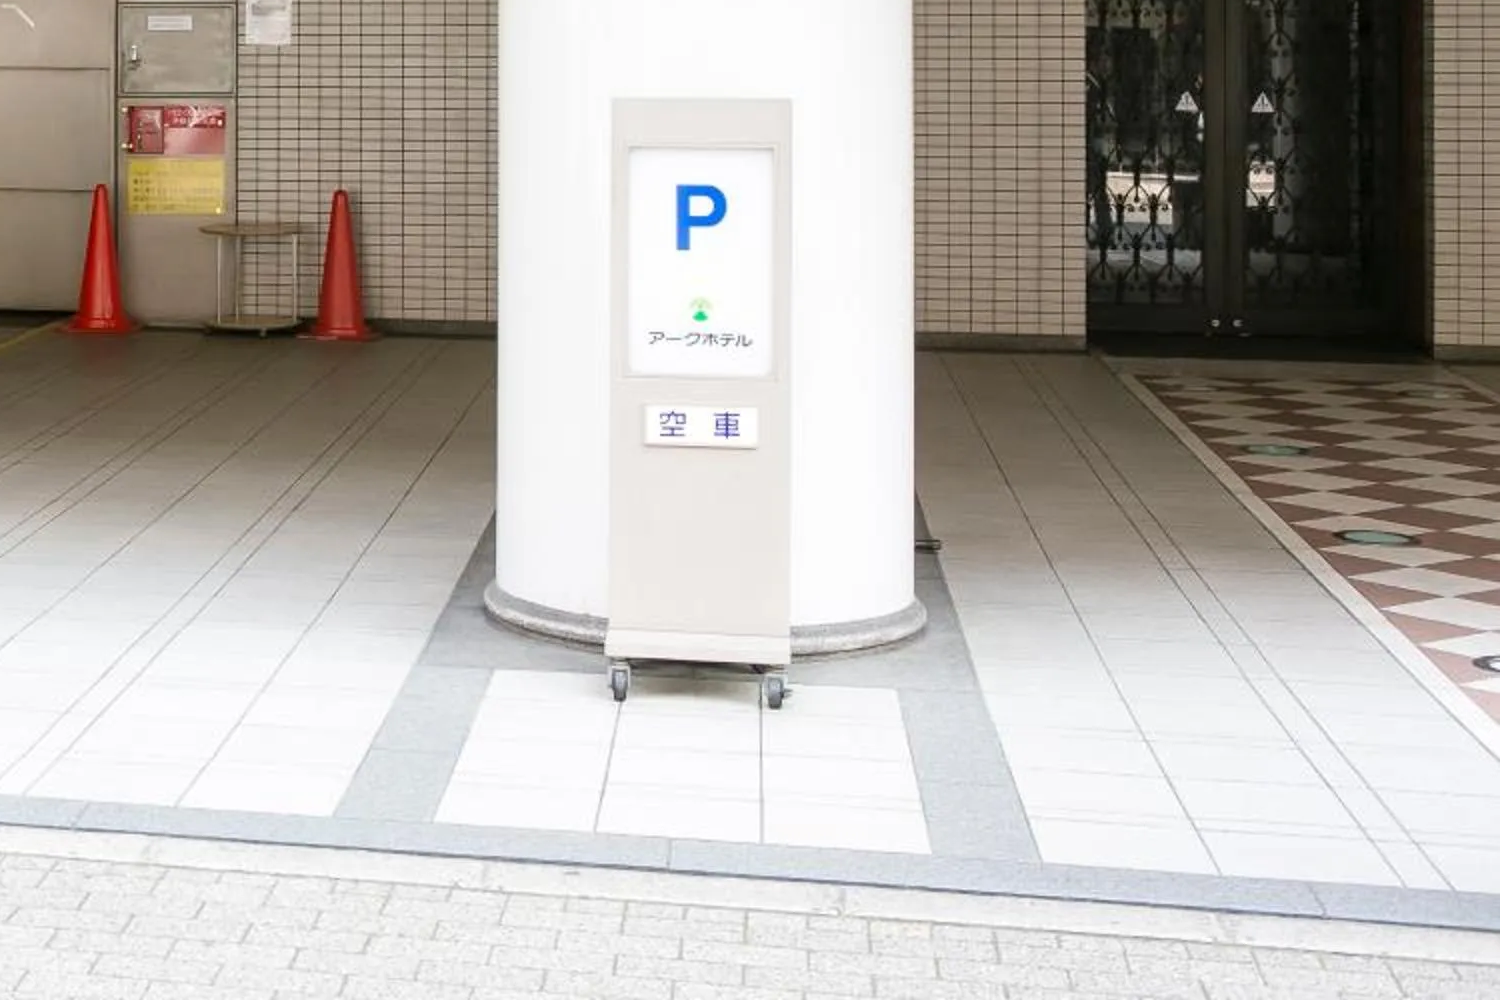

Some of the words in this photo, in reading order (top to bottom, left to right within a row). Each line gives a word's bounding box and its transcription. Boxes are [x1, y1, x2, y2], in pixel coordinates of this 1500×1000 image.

[676, 184, 727, 251] P
[648, 330, 754, 348] アークホテル
